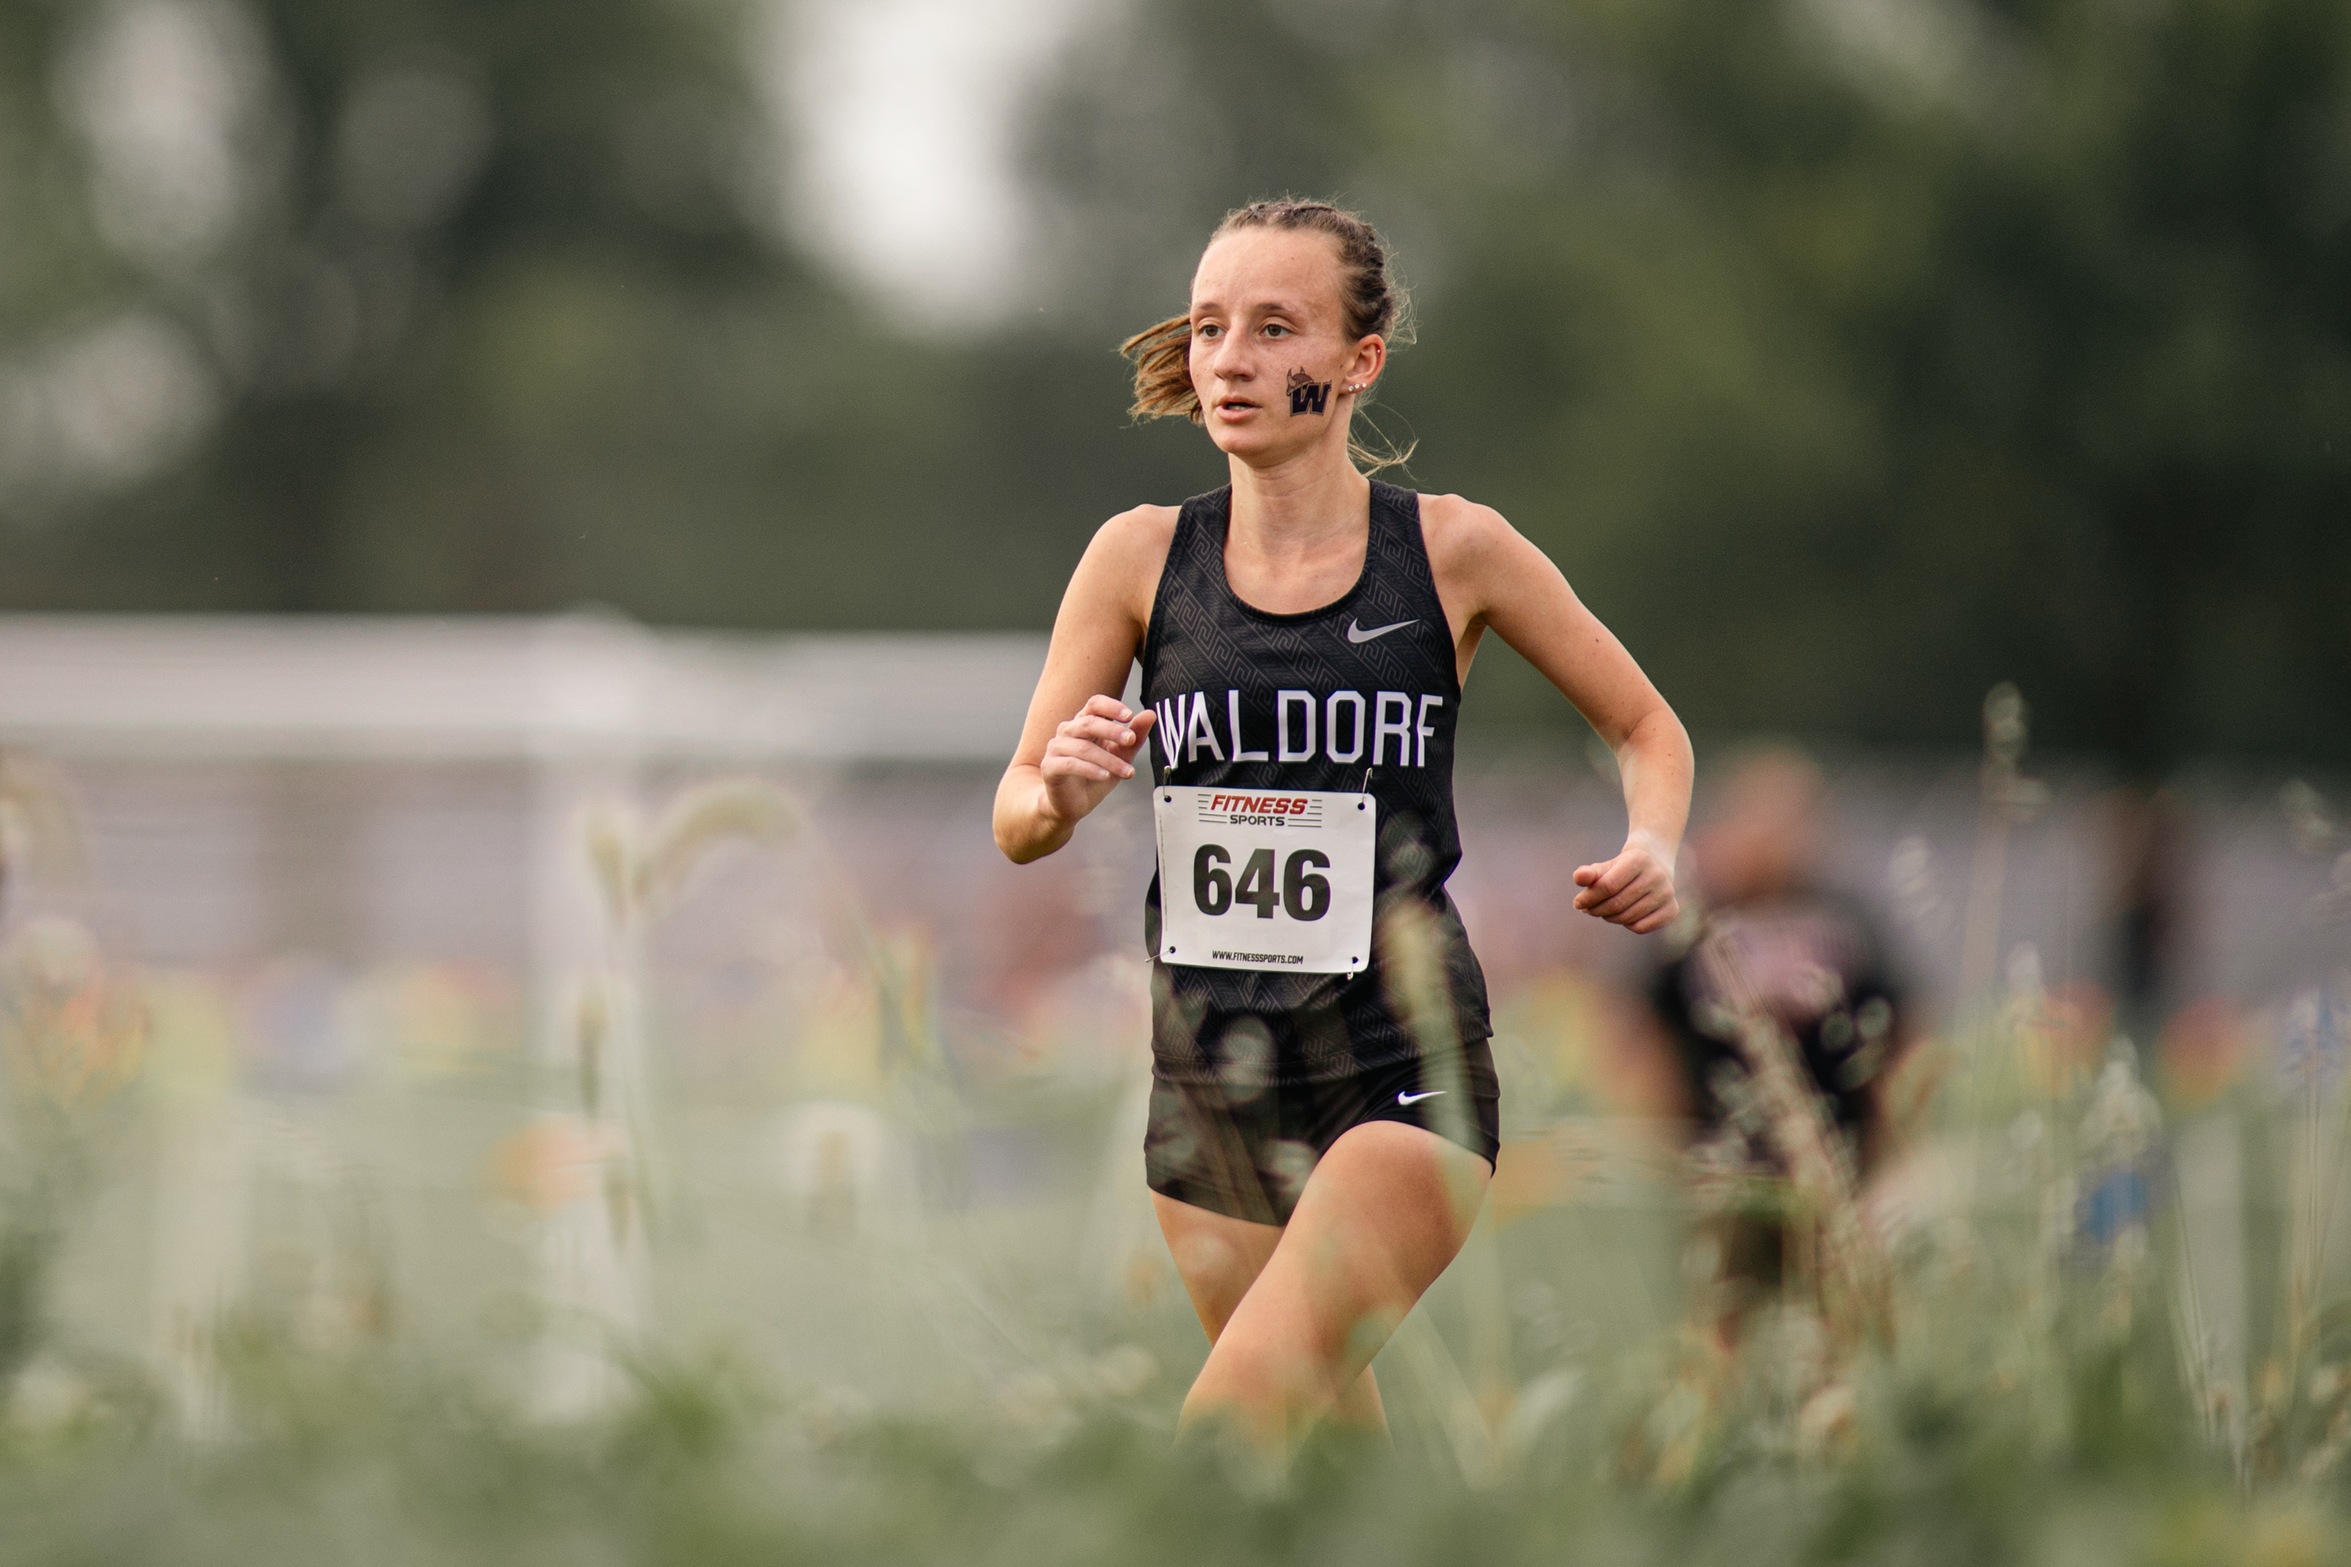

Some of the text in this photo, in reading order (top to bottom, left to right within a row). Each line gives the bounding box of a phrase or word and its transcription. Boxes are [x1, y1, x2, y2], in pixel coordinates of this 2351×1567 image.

[1156, 689, 1443, 769] WALDORF
[1210, 794, 1308, 815] FITNESS
[1229, 815, 1285, 827] SPORTS
[1193, 843, 1331, 922] 646
[1212, 950, 1304, 965] WWW.FITNESSSPORTS.COM
